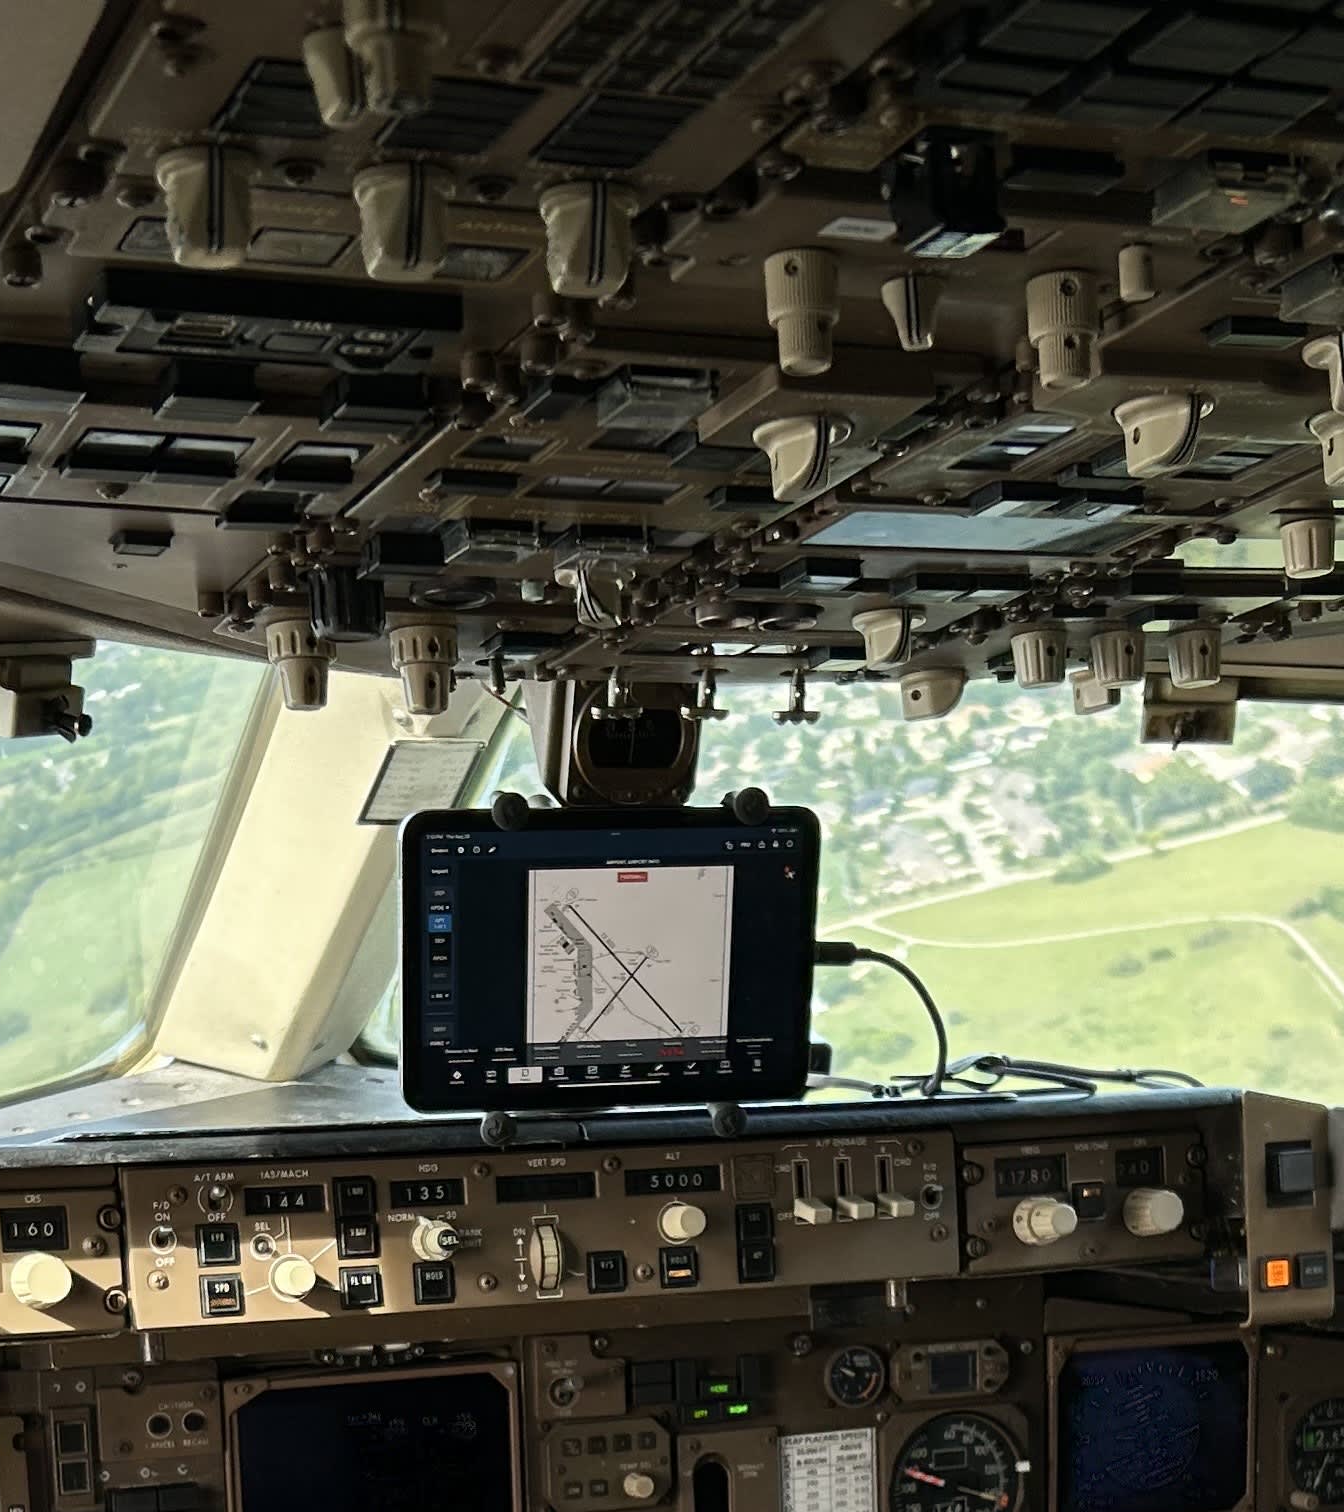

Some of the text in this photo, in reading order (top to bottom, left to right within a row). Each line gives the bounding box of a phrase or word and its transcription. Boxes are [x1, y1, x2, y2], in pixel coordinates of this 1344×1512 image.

[528, 1158, 547, 1168] VERT
[193, 1171, 236, 1183] A/T ARM
[260, 1169, 309, 1180] IAS/MACH
[650, 1175, 703, 1188] 5000
[406, 1186, 445, 1201] 135
[152, 1201, 171, 1210] F/D
[264, 1193, 305, 1208] 144
[155, 1212, 171, 1222] ON
[207, 1212, 227, 1223] OFF
[387, 1213, 415, 1223] NORM
[11, 1222, 55, 1237] 160
[254, 1222, 271, 1232] SEL
[441, 1236, 459, 1246] SEL
[155, 1256, 176, 1268] OFF
[214, 1282, 230, 1294] SPD
